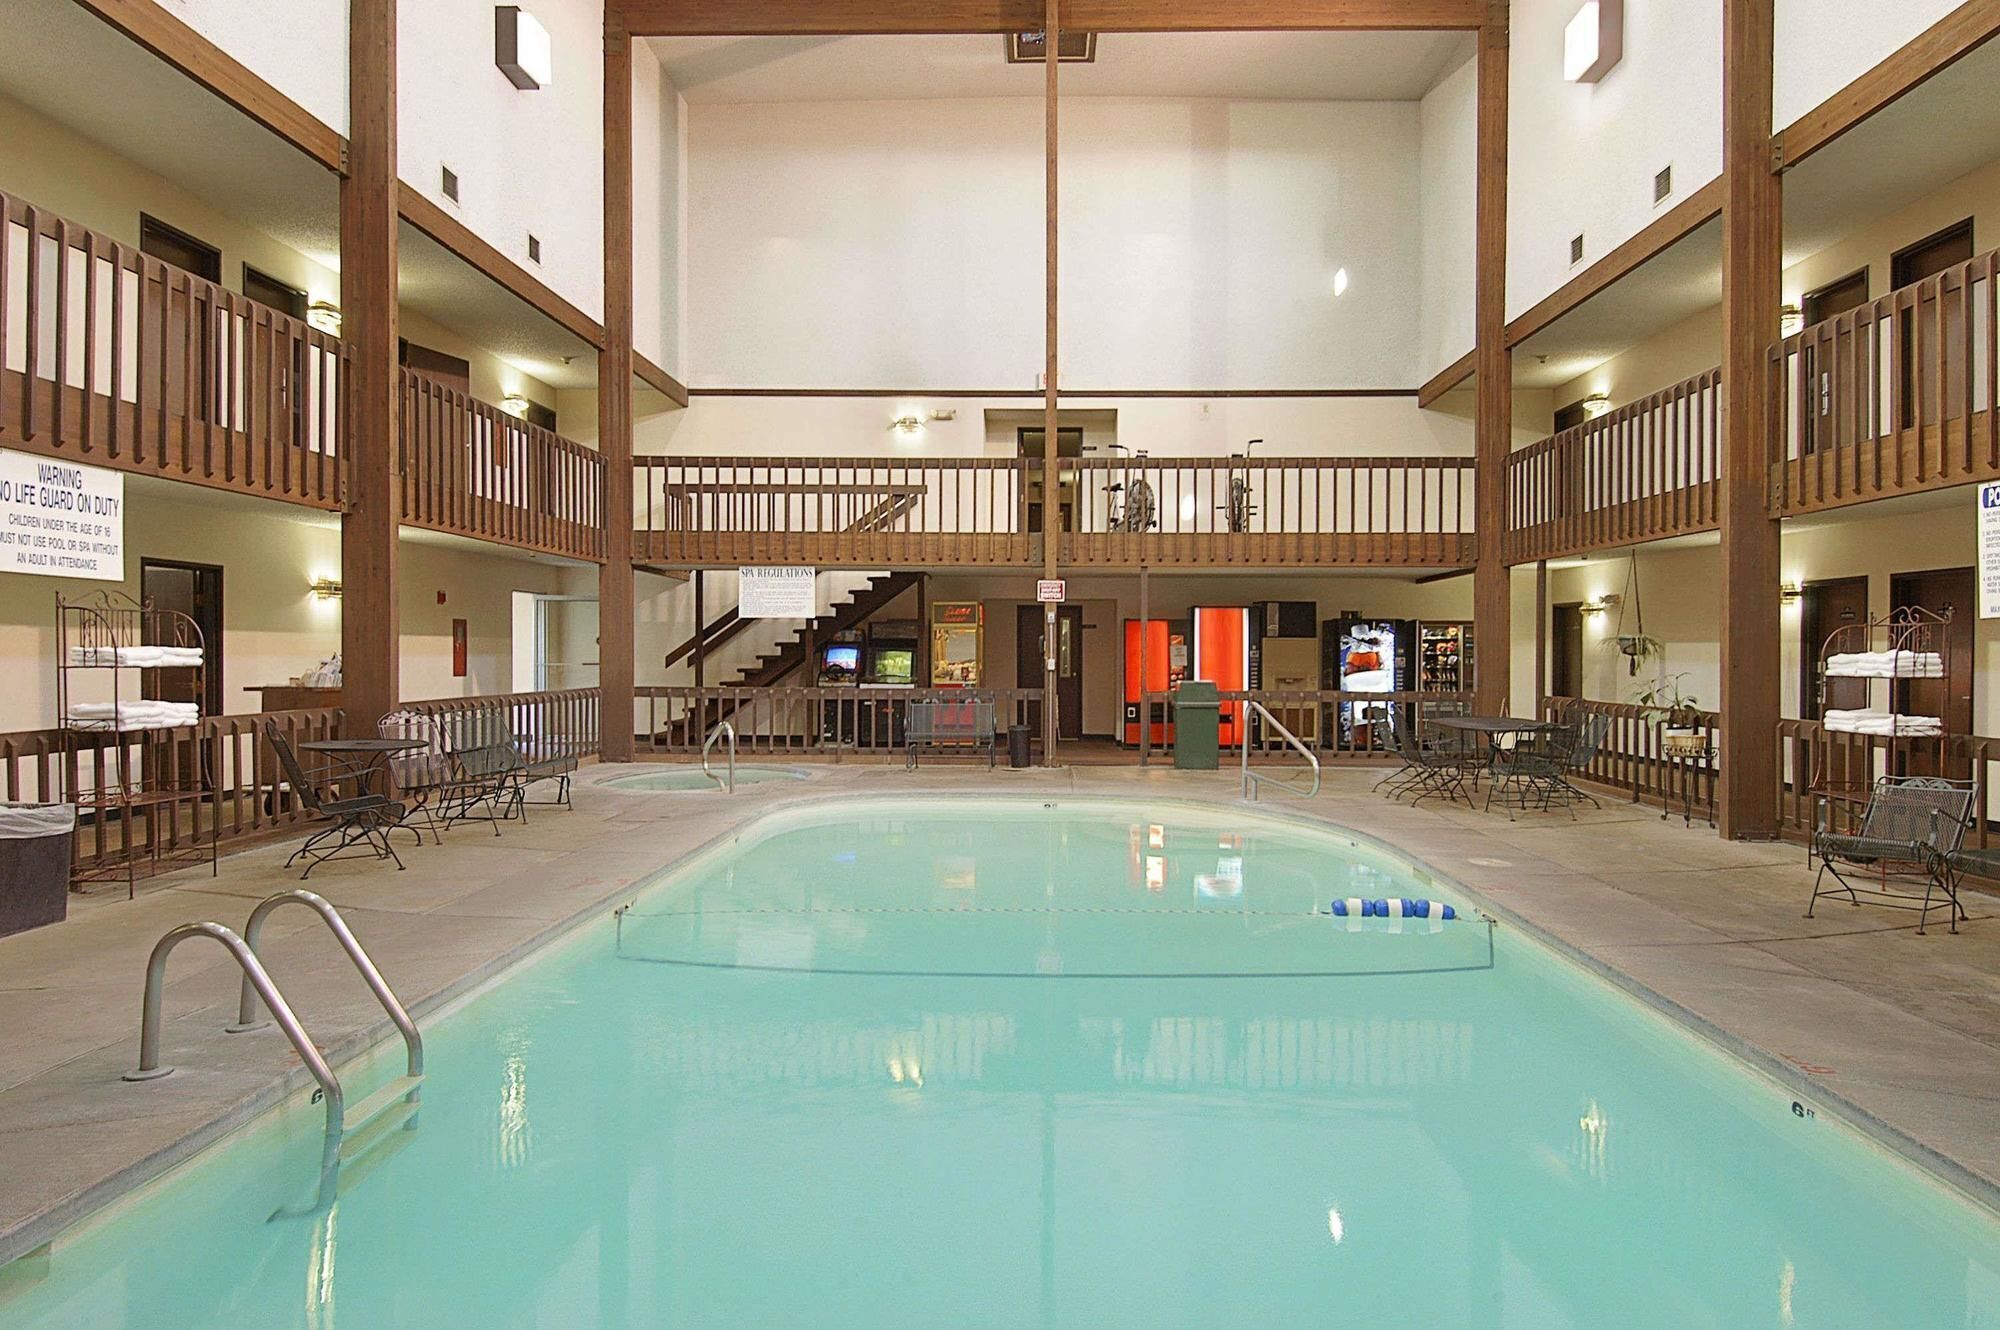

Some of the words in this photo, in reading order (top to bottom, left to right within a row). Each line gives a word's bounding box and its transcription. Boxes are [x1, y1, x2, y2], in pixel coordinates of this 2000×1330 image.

[38, 464, 82, 489] WARNING
[15, 483, 36, 505] LIFE
[40, 488, 73, 510] GUARD
[77, 493, 91, 513] ON
[95, 496, 119, 517] DUTY
[9, 513, 41, 529] CHILDREN
[43, 519, 65, 531] UNDER
[66, 521, 78, 533] THE
[80, 523, 92, 535] AGE
[94, 525, 103, 536] OF
[18, 534, 31, 546] NOT
[33, 536, 46, 548] USE
[48, 537, 66, 550] POOL
[67, 540, 77, 551] OR
[79, 541, 91, 552] SPA
[92, 543, 119, 556] WITHOUT
[17, 552, 27, 563] AN
[28, 553, 48, 566] ADULT
[49, 556, 57, 567] IN
[58, 557, 98, 571] ATTENDANCE
[741, 568, 754, 578] SPA
[757, 568, 813, 578] REGULATIONS
